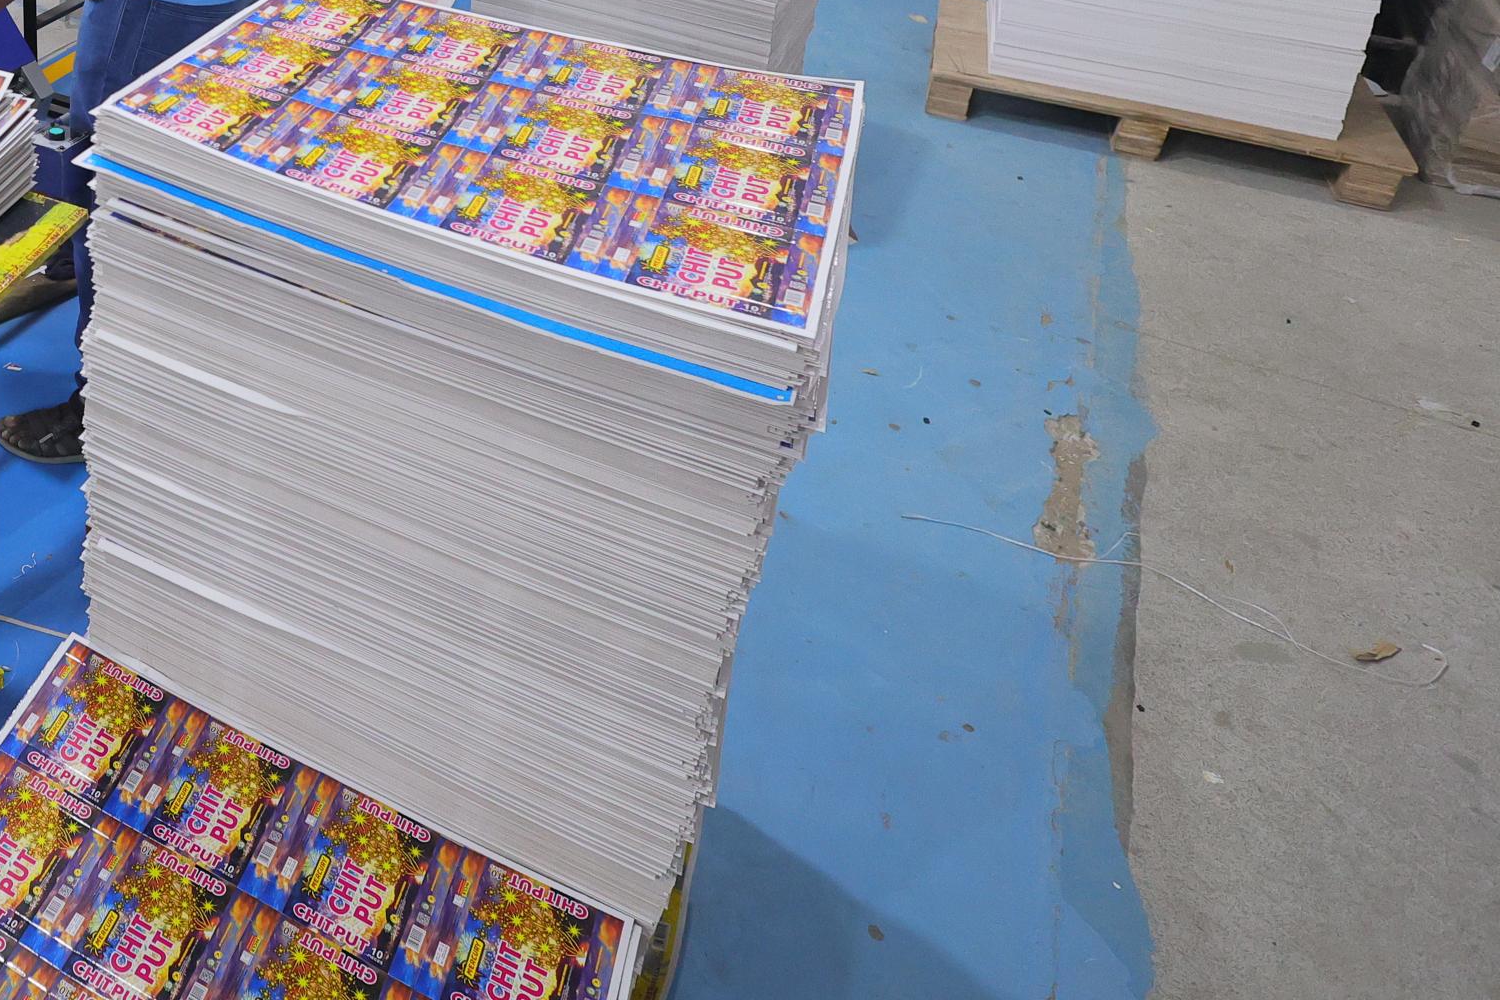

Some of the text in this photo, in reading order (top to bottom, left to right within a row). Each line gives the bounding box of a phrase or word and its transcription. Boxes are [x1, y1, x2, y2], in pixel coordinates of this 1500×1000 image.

[241, 52, 277, 74] CHIT
[263, 59, 297, 81] PUT
[574, 67, 604, 92] CHIT
[600, 73, 628, 96] PUT
[172, 101, 212, 126] CHIT
[380, 90, 415, 116] CHIT
[405, 97, 438, 122] PUT
[735, 98, 764, 125] CHIT
[764, 105, 792, 130] PUT
[195, 110, 233, 134] PUT
[535, 128, 568, 157] CHIT
[562, 135, 594, 163] PUT
[716, 132, 805, 156] CHIT PUT
[321, 149, 360, 179] CHIT
[347, 159, 384, 187] PUT
[709, 166, 741, 198] CHIT
[740, 174, 771, 205] PUT
[487, 198, 525, 232] CHIT
[673, 192, 768, 220] CHIT PUT
[687, 206, 784, 236] CHIT PUT
[517, 207, 553, 239] PUT
[676, 247, 712, 286] CHIT
[709, 257, 744, 294] PUT
[636, 277, 739, 312] CHIT PUT
[102, 664, 163, 702] CHIT PUT
[44, 712, 69, 742] MERCURY
[59, 714, 97, 761] CHIT
[79, 727, 115, 771] PUT
[224, 726, 291, 768] CHIT PUT
[27, 751, 92, 794] CHIT PUT
[27, 772, 92, 817] CHIT PUT
[89, 787, 102, 799] 10
[170, 780, 193, 812] MERCURY
[186, 781, 224, 834] CHIT
[209, 796, 244, 845] PUT
[358, 795, 432, 842] CHIT PUT
[153, 822, 224, 870] CHIT PUT
[155, 845, 227, 895] CHIT PUT
[222, 862, 236, 876] 10
[309, 854, 331, 890] MERCURY
[328, 856, 364, 914] CHIT
[353, 872, 388, 927] PUT
[507, 871, 545, 901] PUT
[543, 889, 589, 923] CHIT
[5, 918, 19, 932] 10
[93, 909, 119, 947] MERCURY
[294, 901, 371, 954] CHIT PUT
[110, 911, 152, 973] CHIT
[134, 928, 174, 987] PUT
[299, 927, 378, 983] CHIT PUT
[370, 946, 385, 961] 10
[464, 937, 485, 977] MERCURY
[73, 959, 114, 994] CHIT
